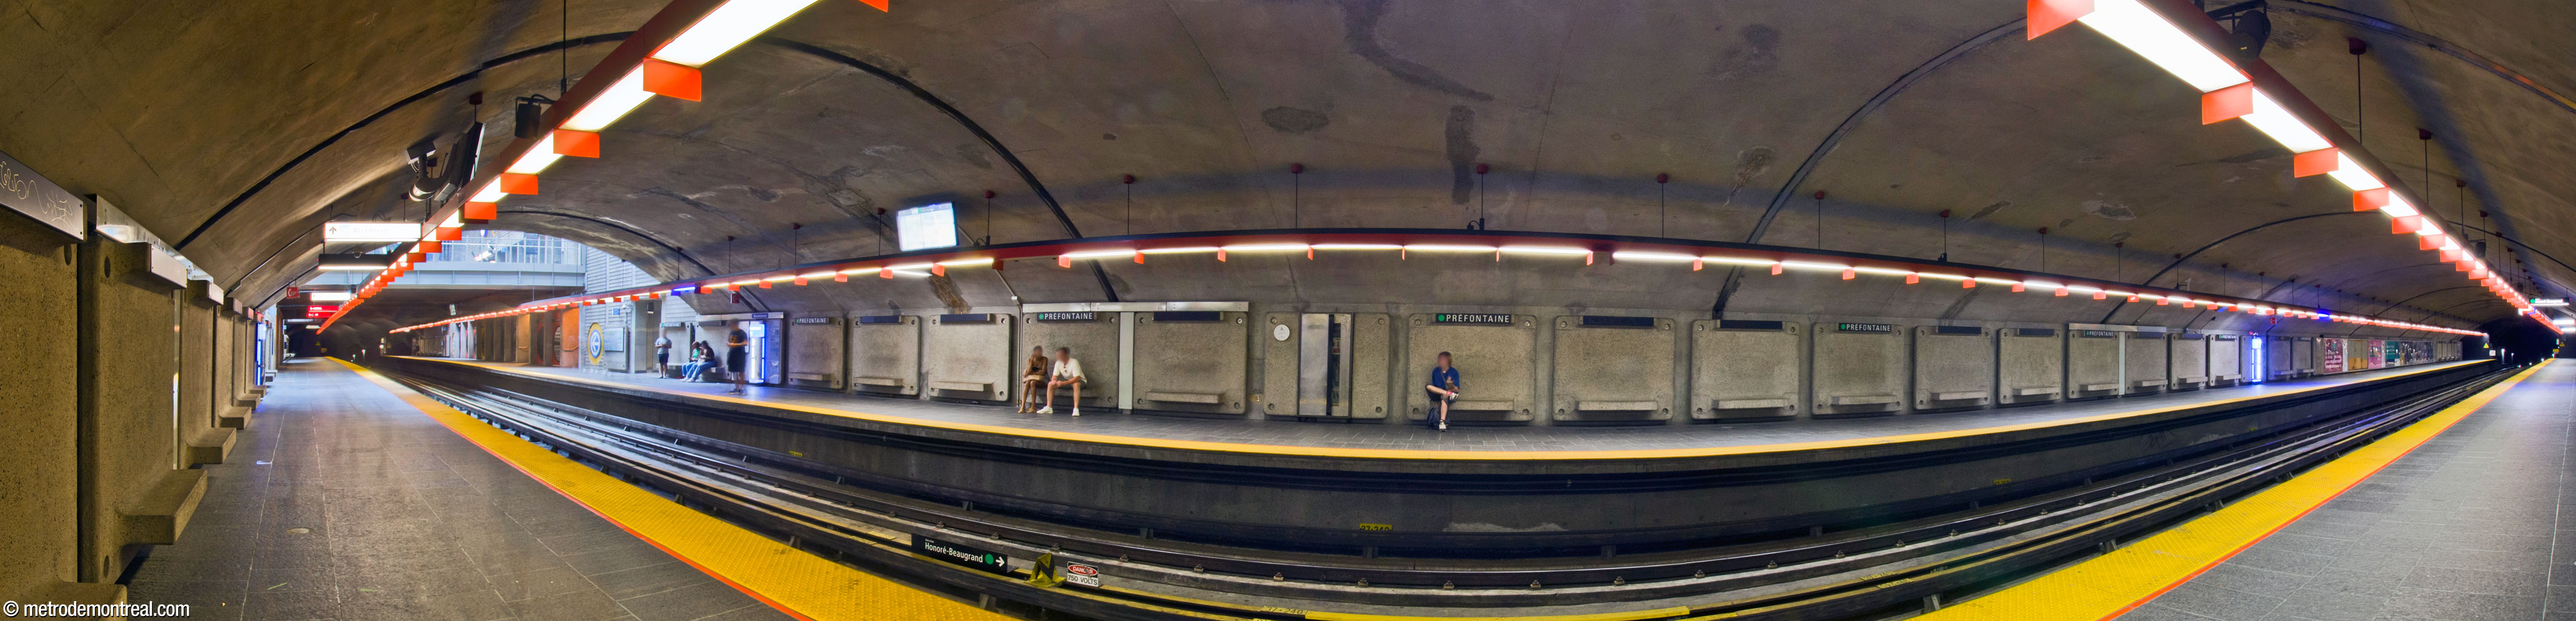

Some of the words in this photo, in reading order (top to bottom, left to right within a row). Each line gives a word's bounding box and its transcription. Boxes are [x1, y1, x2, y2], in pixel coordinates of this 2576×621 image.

[1446, 314, 1509, 323] PRÉFONTAINE
[1846, 324, 1891, 332] PRÉFONTAINE
[924, 542, 983, 563] Honoré-Beaugrand
[1080, 577, 1098, 586] VOLTS
